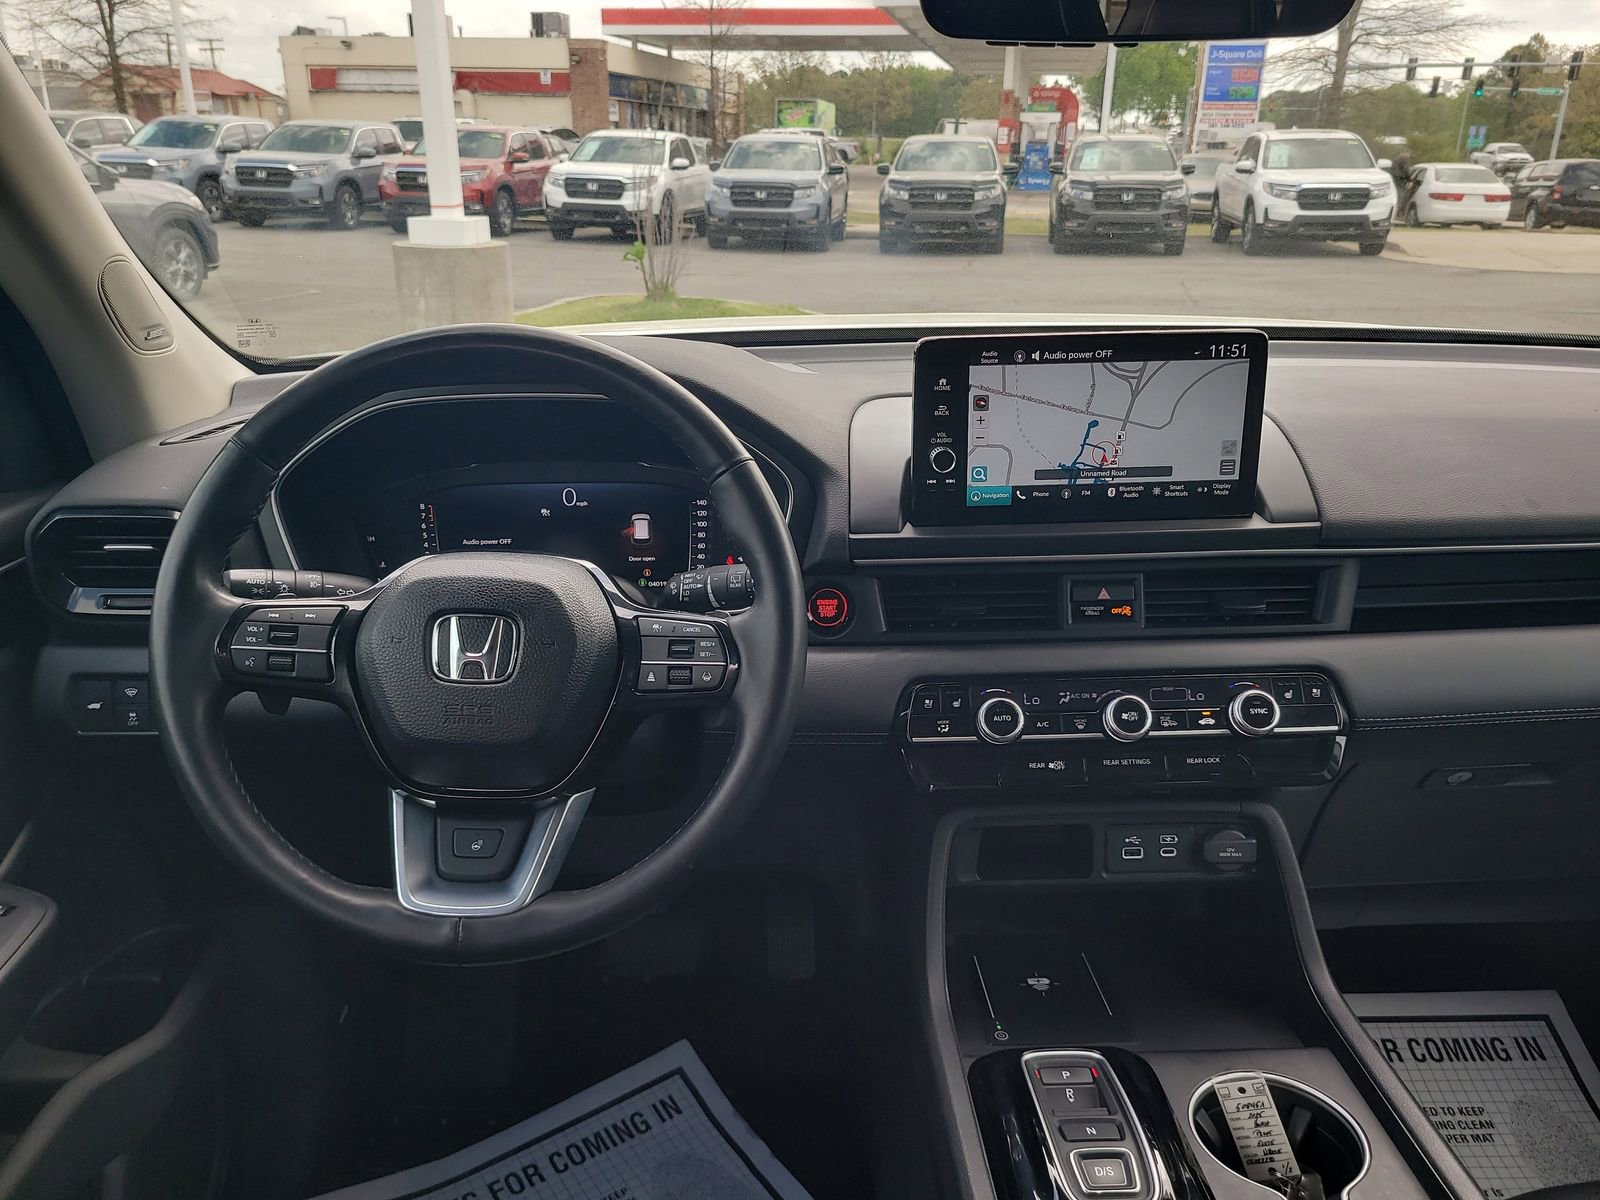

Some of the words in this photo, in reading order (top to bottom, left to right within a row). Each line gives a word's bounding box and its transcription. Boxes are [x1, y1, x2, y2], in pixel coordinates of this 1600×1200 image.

[1211, 50, 1245, 60] J-Square
[1246, 49, 1262, 59] Deli
[1043, 351, 1066, 360] Audio
[1068, 352, 1093, 362] power
[1095, 350, 1113, 359] OFF
[1210, 344, 1248, 358] 11:51
[1212, 482, 1231, 490] Display
[982, 492, 1009, 500] Navigation
[480, 539, 498, 547] power
[993, 714, 1012, 722] AUTO
[1121, 758, 1151, 766] SETTINGS
[1407, 1036, 1513, 1063] COMING
[1514, 1036, 1548, 1062] IN
[1061, 1070, 1071, 1080] P
[1065, 1088, 1075, 1099] R
[1440, 1106, 1457, 1117] TO
[1458, 1106, 1486, 1117] KEEP
[1085, 1126, 1097, 1135] N
[1432, 1121, 1456, 1131] ING
[1457, 1119, 1496, 1130] CLEAN
[1472, 1133, 1497, 1144] MAT
[487, 1163, 547, 1200] FOR
[548, 1111, 653, 1175] COMING
[651, 1094, 684, 1123] IN
[1094, 1166, 1114, 1177] D/S
